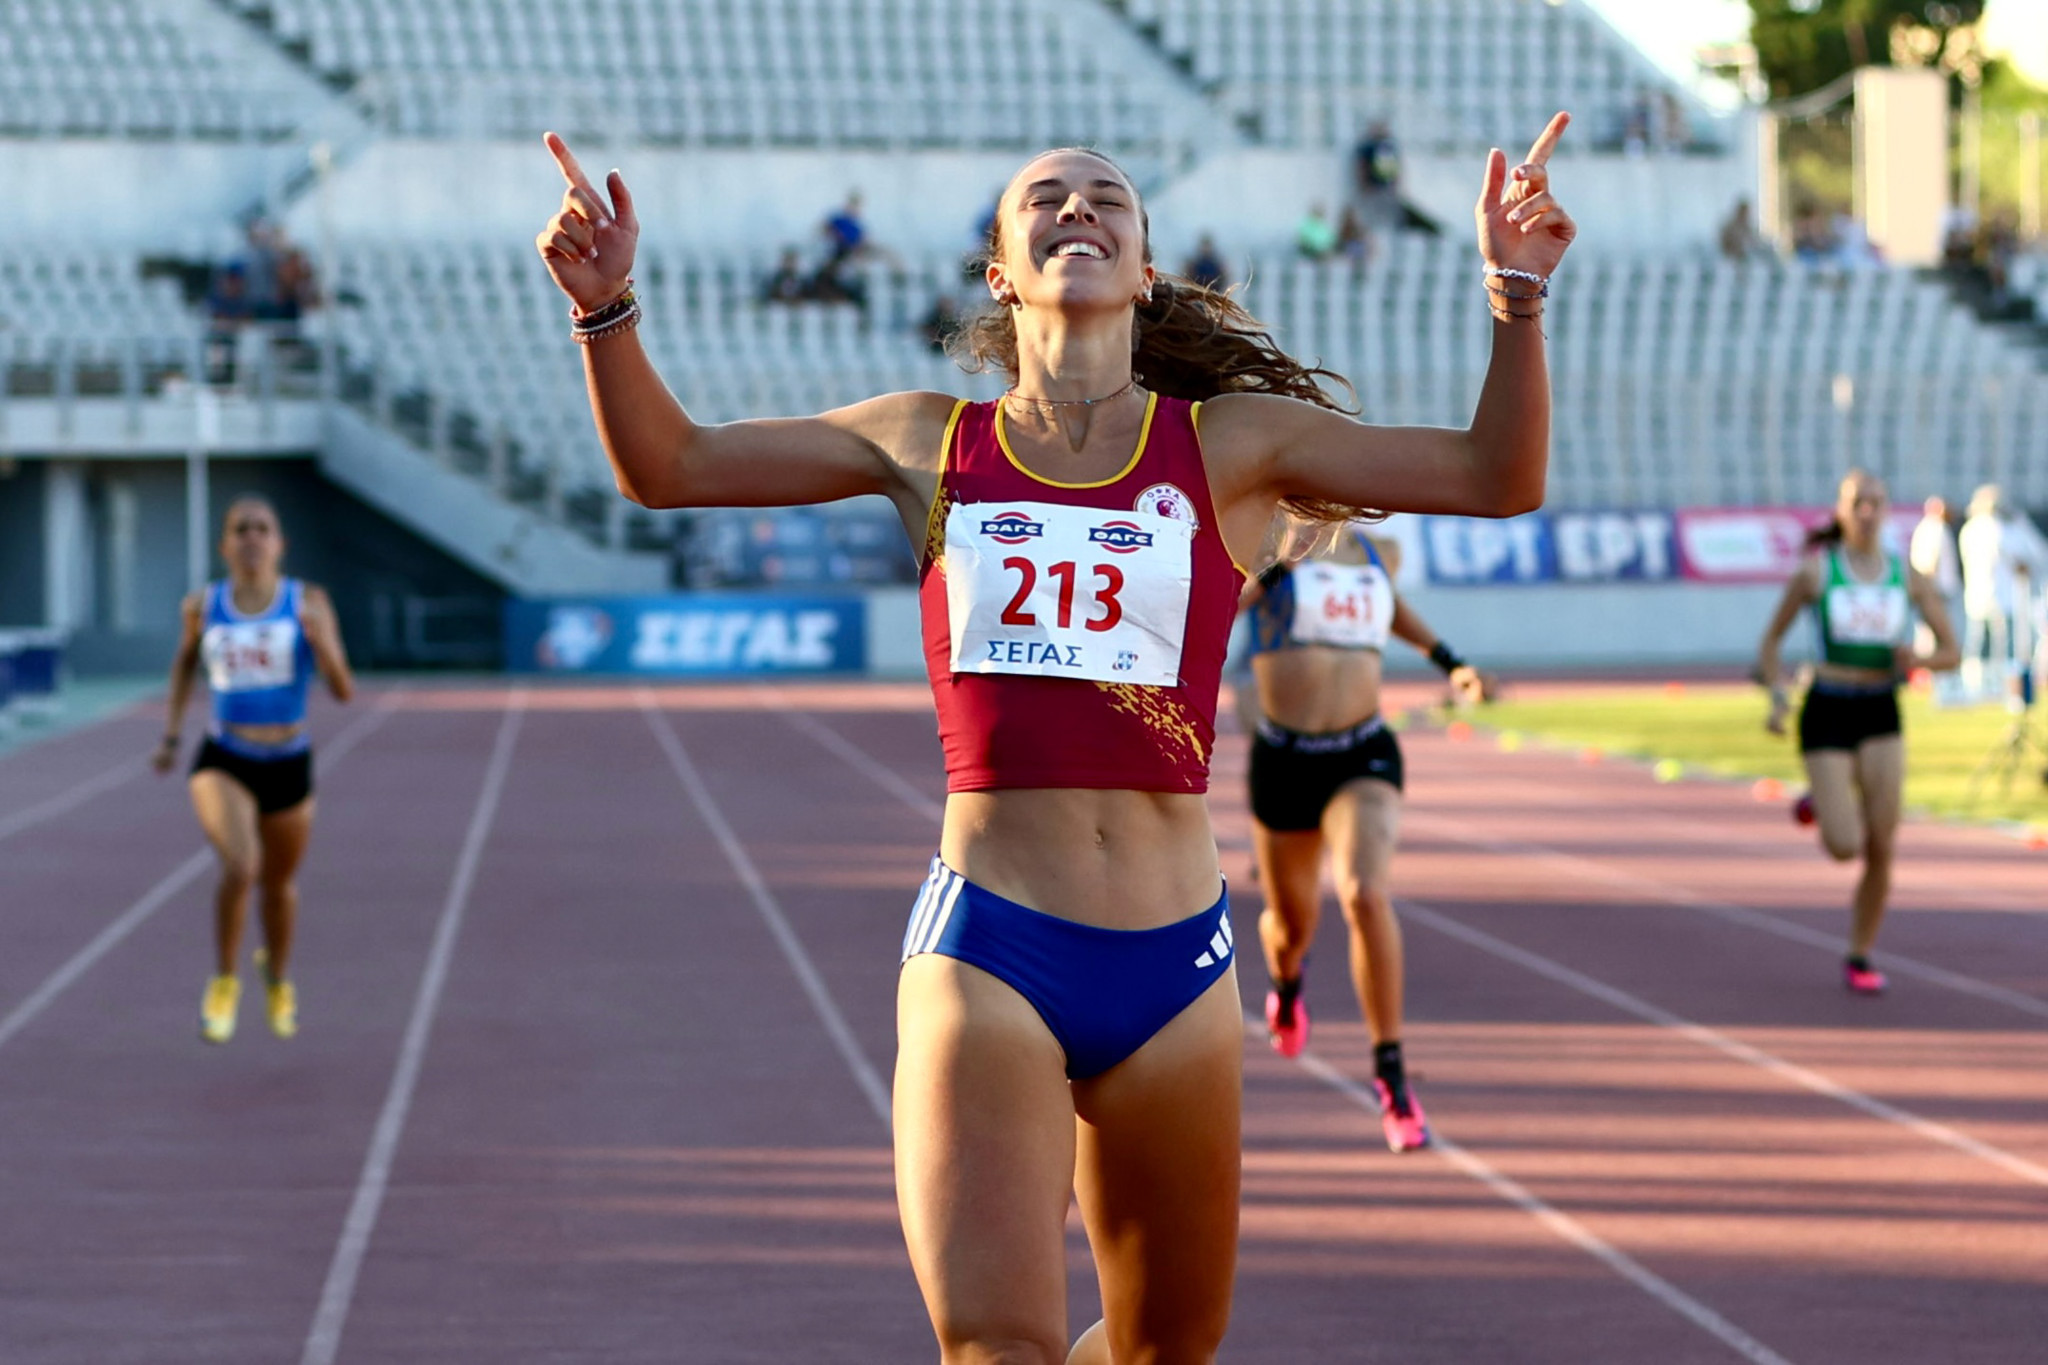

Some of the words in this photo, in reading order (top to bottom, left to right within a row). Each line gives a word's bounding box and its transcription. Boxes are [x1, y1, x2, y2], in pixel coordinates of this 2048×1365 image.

[1000, 556, 1124, 632] 213
[630, 609, 840, 667] ΣΕΓΑΣ
[987, 640, 1083, 667] ΣΕΓΑΣ
